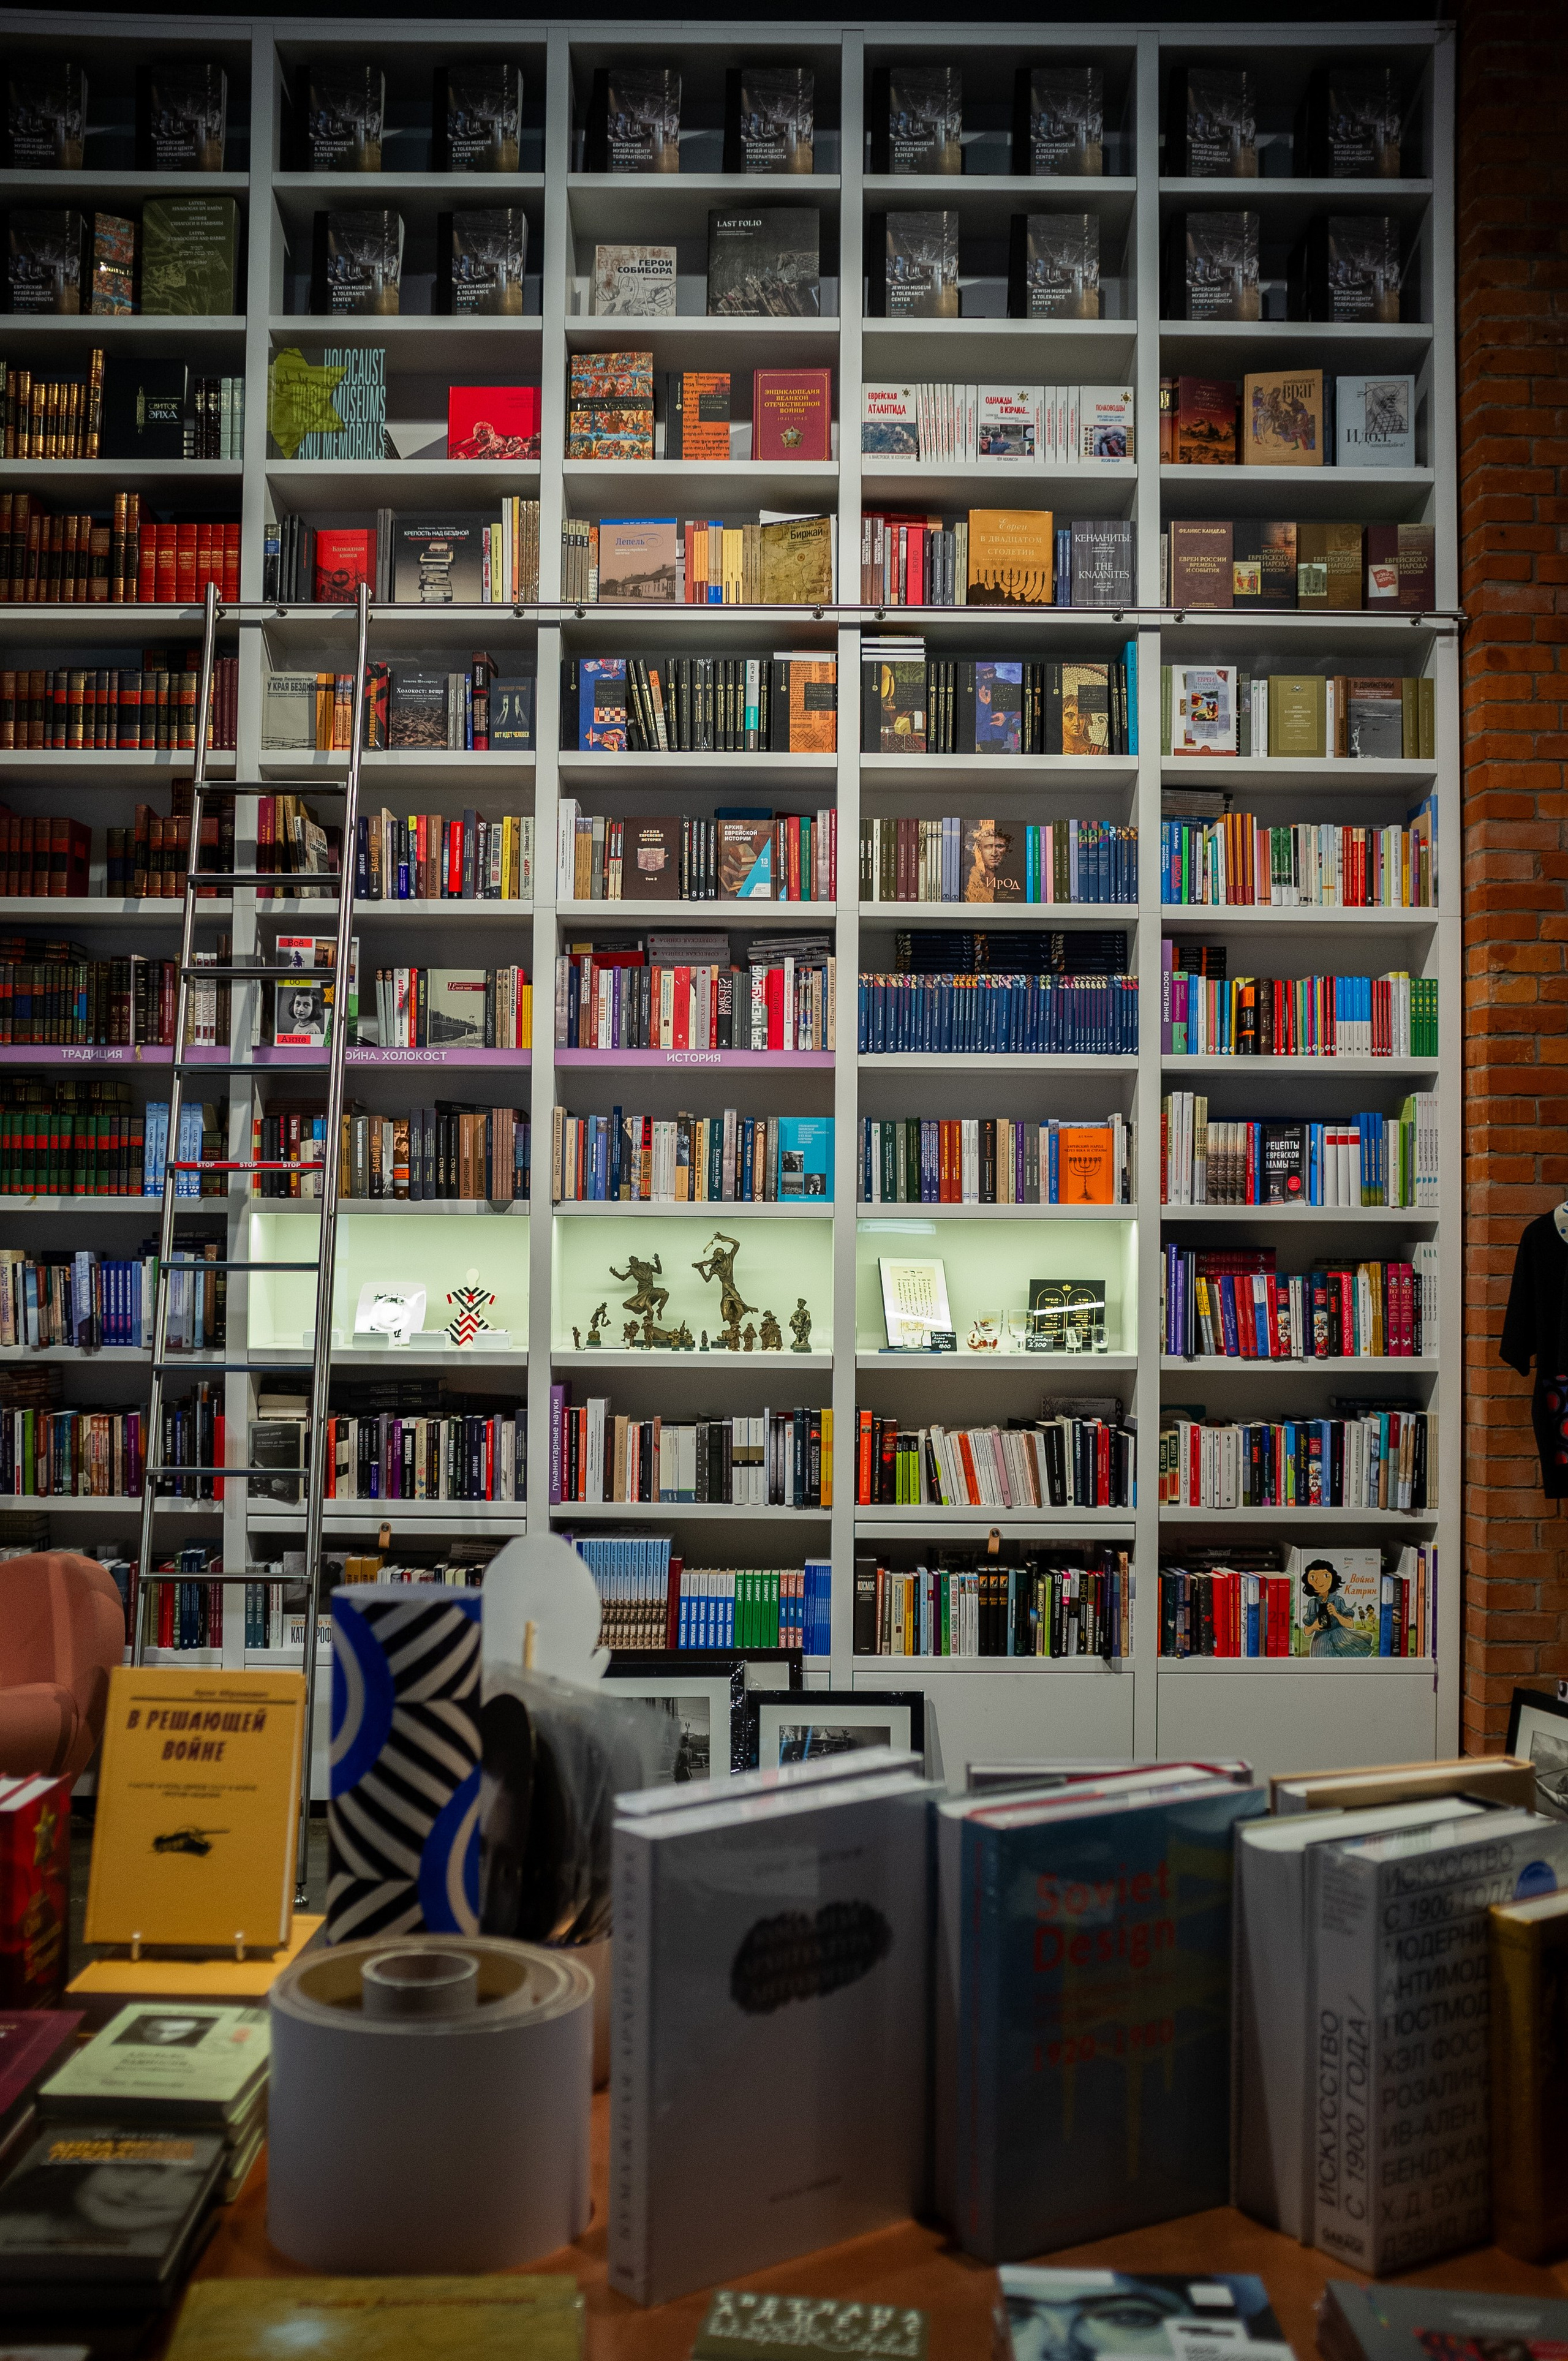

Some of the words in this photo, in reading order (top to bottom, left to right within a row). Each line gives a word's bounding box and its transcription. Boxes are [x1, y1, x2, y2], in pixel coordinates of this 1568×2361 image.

[324, 348, 385, 385] HOLOCAUST
[868, 391, 897, 401] ЕВРЕЙСКАЯ
[1283, 383, 1315, 402] враг
[333, 385, 385, 423] MUSEUMS
[986, 396, 1012, 405] ОДНАЖДЫ
[868, 404, 906, 415] АТЛАНТИДА
[323, 423, 385, 459] MEMORIALS
[790, 528, 823, 540] Биржай
[989, 535, 1041, 544] ДВАДЦАТОМ
[1076, 533, 1132, 543] КЕНААНИТЫ:
[616, 537, 644, 546] Лепель
[1079, 570, 1129, 579] KNAANITES
[268, 682, 272, 691] У
[273, 682, 287, 691] КРАЯ
[288, 682, 317, 691] БЕЗДНЫ
[369, 678, 377, 747] БЛАГОВОЛИТЕЛЬНИЦЫ
[372, 835, 379, 846] ЯР
[752, 965, 762, 1025] МЕРКУРИЯ
[752, 1028, 762, 1050] ЭРА
[62, 1050, 123, 1059] ТРАДИЦИЯ
[344, 1050, 379, 1061] ОЙНА.
[382, 1051, 447, 1061] ХОЛОКОСТ
[666, 1053, 721, 1063] ИСТОРИЯ
[372, 1135, 379, 1146] ЯР
[1266, 1141, 1299, 1150] РЕЦЕПТЫ
[1266, 1151, 1299, 1159] ЕВРЕЙСКОЙ
[1266, 1160, 1288, 1169] МАМЫ
[1351, 1573, 1374, 1584] Война
[858, 1582, 875, 1591] КОСМОС
[1344, 1584, 1377, 1598] Катрин
[127, 1709, 140, 1729] В
[146, 1709, 267, 1733] РЕШАЮЩЕЙ
[162, 1737, 225, 1761] ВОЙНЕ
[1384, 1842, 1514, 1894] ИСКУССТВО
[1036, 1859, 1172, 1921] Soviet
[1384, 1902, 1401, 1930] С
[1409, 1893, 1454, 1926] 1900
[1033, 1915, 1176, 1973] Design
[1383, 1956, 1488, 2000] АНТИМОД
[1383, 1994, 1489, 2039] ПОСТМОД
[1382, 2041, 1427, 2076] ХЭЛ
[1431, 2027, 1489, 2063] ФОСТ
[1317, 2009, 1341, 2208] ИСКУССТВО
[1346, 2112, 1368, 2183] 1900
[1346, 2197, 1365, 2221] С
